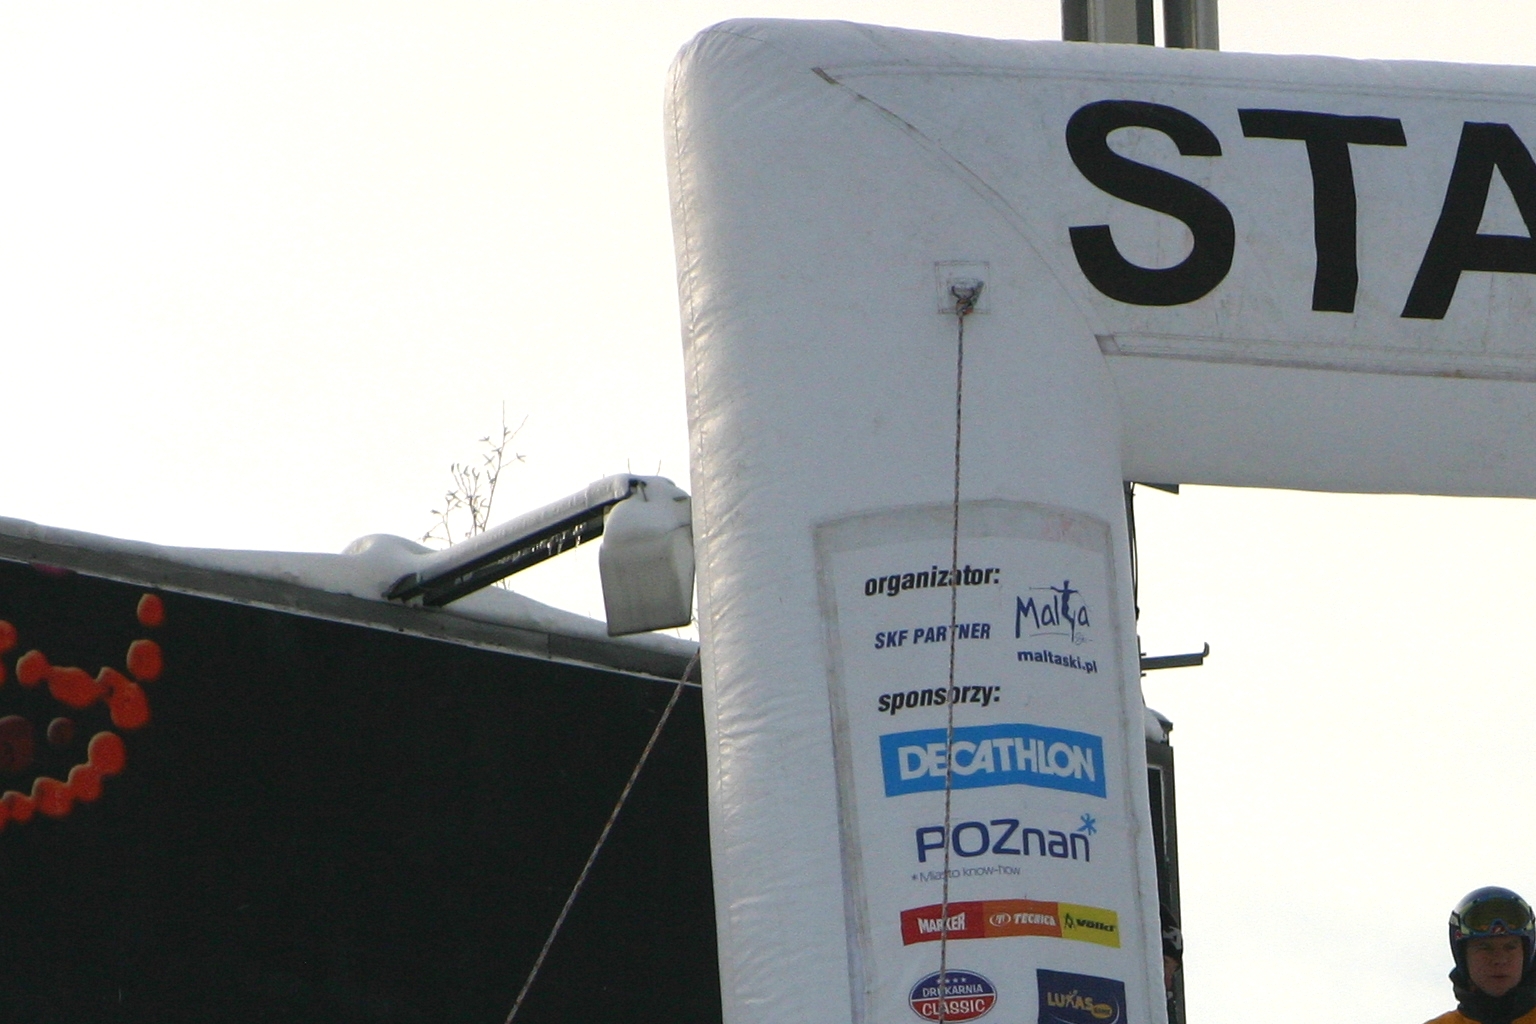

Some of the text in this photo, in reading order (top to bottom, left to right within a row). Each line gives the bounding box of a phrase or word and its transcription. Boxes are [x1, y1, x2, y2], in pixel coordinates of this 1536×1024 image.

[864, 564, 1000, 597] organizator:
[874, 629, 908, 650] SKF
[1016, 649, 1098, 673] maltaski.pl
[878, 684, 1000, 716] sponsorzy:
[897, 737, 1096, 783] DECATHLON
[917, 912, 966, 935] MARKER
[1014, 912, 1057, 926] TECNICA
[922, 983, 984, 998] DRUKARNIA
[922, 998, 987, 1017] CLASSIC
